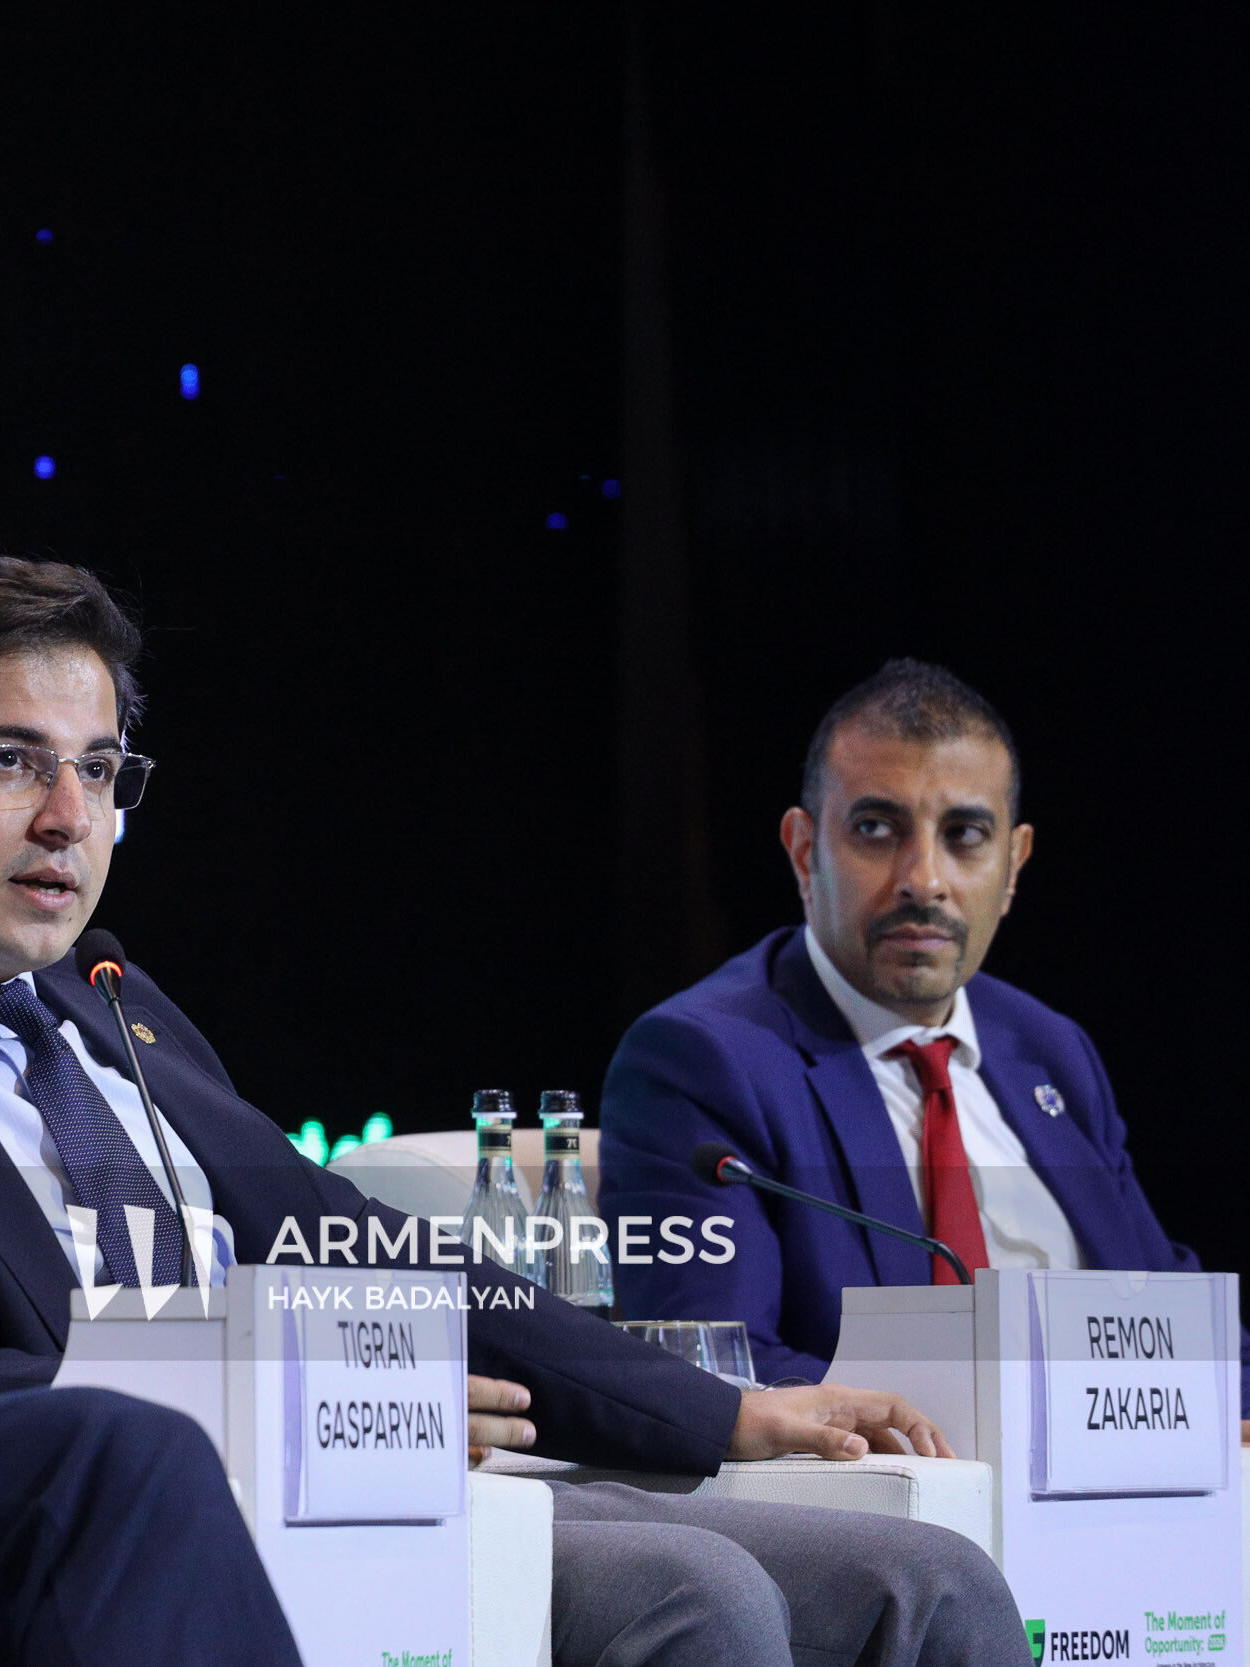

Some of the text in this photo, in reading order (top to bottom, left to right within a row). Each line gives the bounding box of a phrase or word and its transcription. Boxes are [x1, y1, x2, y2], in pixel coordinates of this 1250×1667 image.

[337, 1321, 416, 1370] TIGRAN
[1086, 1316, 1174, 1360] REMON
[317, 1401, 445, 1451] GASPARYAN
[1086, 1387, 1190, 1430] ZAKARIA
[1144, 1610, 1226, 1631] The Moment of
[1051, 1629, 1130, 1662] FREEDOM
[1144, 1636, 1204, 1657] Opportunity:
